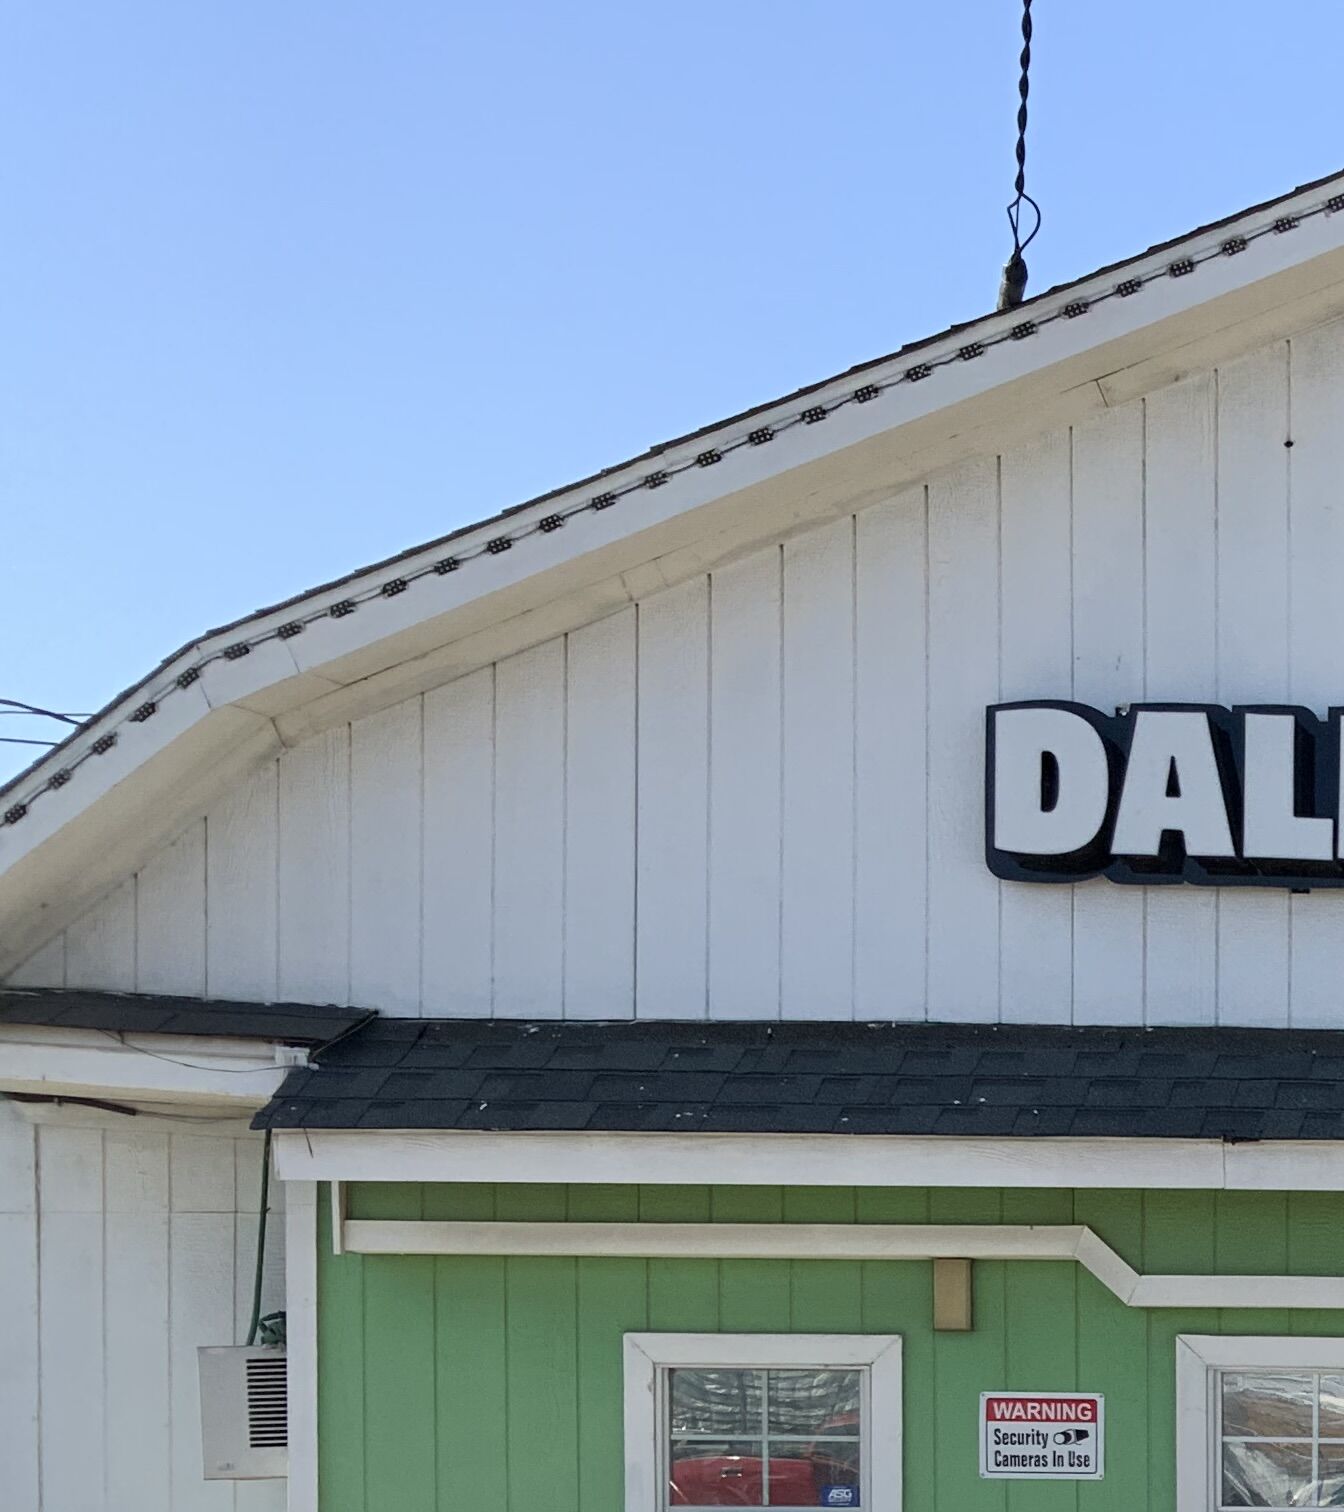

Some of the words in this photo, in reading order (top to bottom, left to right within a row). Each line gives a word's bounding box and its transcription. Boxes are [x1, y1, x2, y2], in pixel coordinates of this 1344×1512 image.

[992, 1401, 1093, 1420] WARNING
[993, 1428, 1049, 1449] Security
[994, 1450, 1049, 1468] Cameras
[1052, 1450, 1065, 1468] In
[1068, 1450, 1091, 1468] Use
